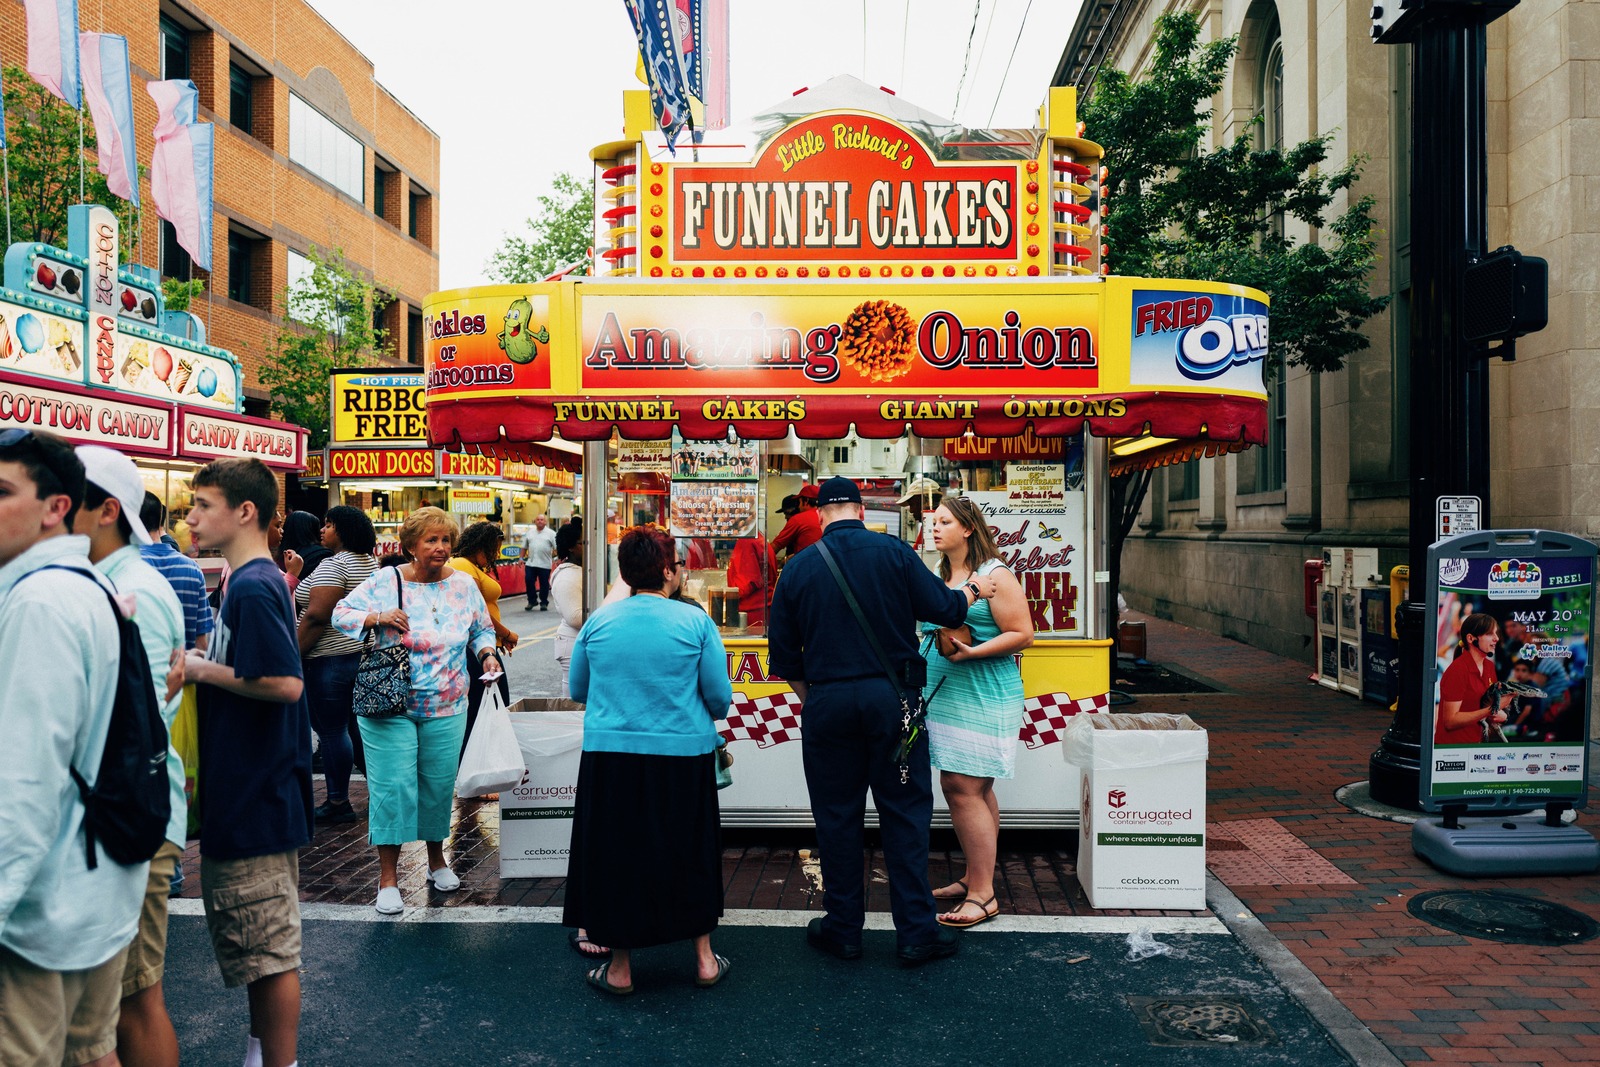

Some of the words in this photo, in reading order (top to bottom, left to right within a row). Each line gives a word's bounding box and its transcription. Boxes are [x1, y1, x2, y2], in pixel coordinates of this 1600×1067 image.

[777, 129, 826, 173] Little
[831, 123, 915, 171] Richard's
[681, 180, 862, 249] FUNNEL
[867, 178, 1013, 249] CAKES
[96, 223, 114, 306] COTTON
[1135, 296, 1214, 338] FRIED
[96, 316, 115, 384] CANDY
[440, 345, 458, 362] or
[585, 311, 841, 381] Amazing
[916, 309, 1098, 370] Onion
[1178, 315, 1268, 374] ORE
[360, 377, 389, 386] HOT
[391, 377, 425, 386] FRES
[343, 388, 427, 412] RIBBO
[554, 401, 681, 421] FUNNEL
[701, 400, 807, 421] CAKES
[879, 400, 979, 421] GIANT
[1003, 397, 1127, 420] ONIONS
[0, 390, 93, 431] COTTON
[97, 407, 164, 440] CANDY
[186, 420, 240, 450] CANDY
[242, 430, 294, 458] APPLES
[944, 431, 998, 454] PICKUP
[1001, 431, 1062, 454] WINDOW
[301, 455, 322, 476] RIES
[332, 451, 380, 475] CORN
[385, 451, 434, 475] DOGS
[449, 454, 496, 476] FRIES
[680, 451, 753, 467] Window
[672, 485, 719, 497] Amazing
[451, 499, 492, 513] Lemonade
[678, 501, 706, 509] Choose
[716, 501, 750, 511] Dressing
[980, 502, 999, 518] Try
[1000, 545, 1076, 572] Velvet
[1015, 572, 1078, 600] NEL
[1549, 573, 1582, 586] FREE!
[1028, 599, 1078, 633] KE
[1513, 610, 1546, 622] MAY
[1542, 644, 1568, 652] Valley
[1108, 808, 1192, 822] corrugated
[1131, 836, 1168, 844] creativity
[1168, 836, 1197, 844] unfolds
[1120, 877, 1180, 885] cccbox.com
